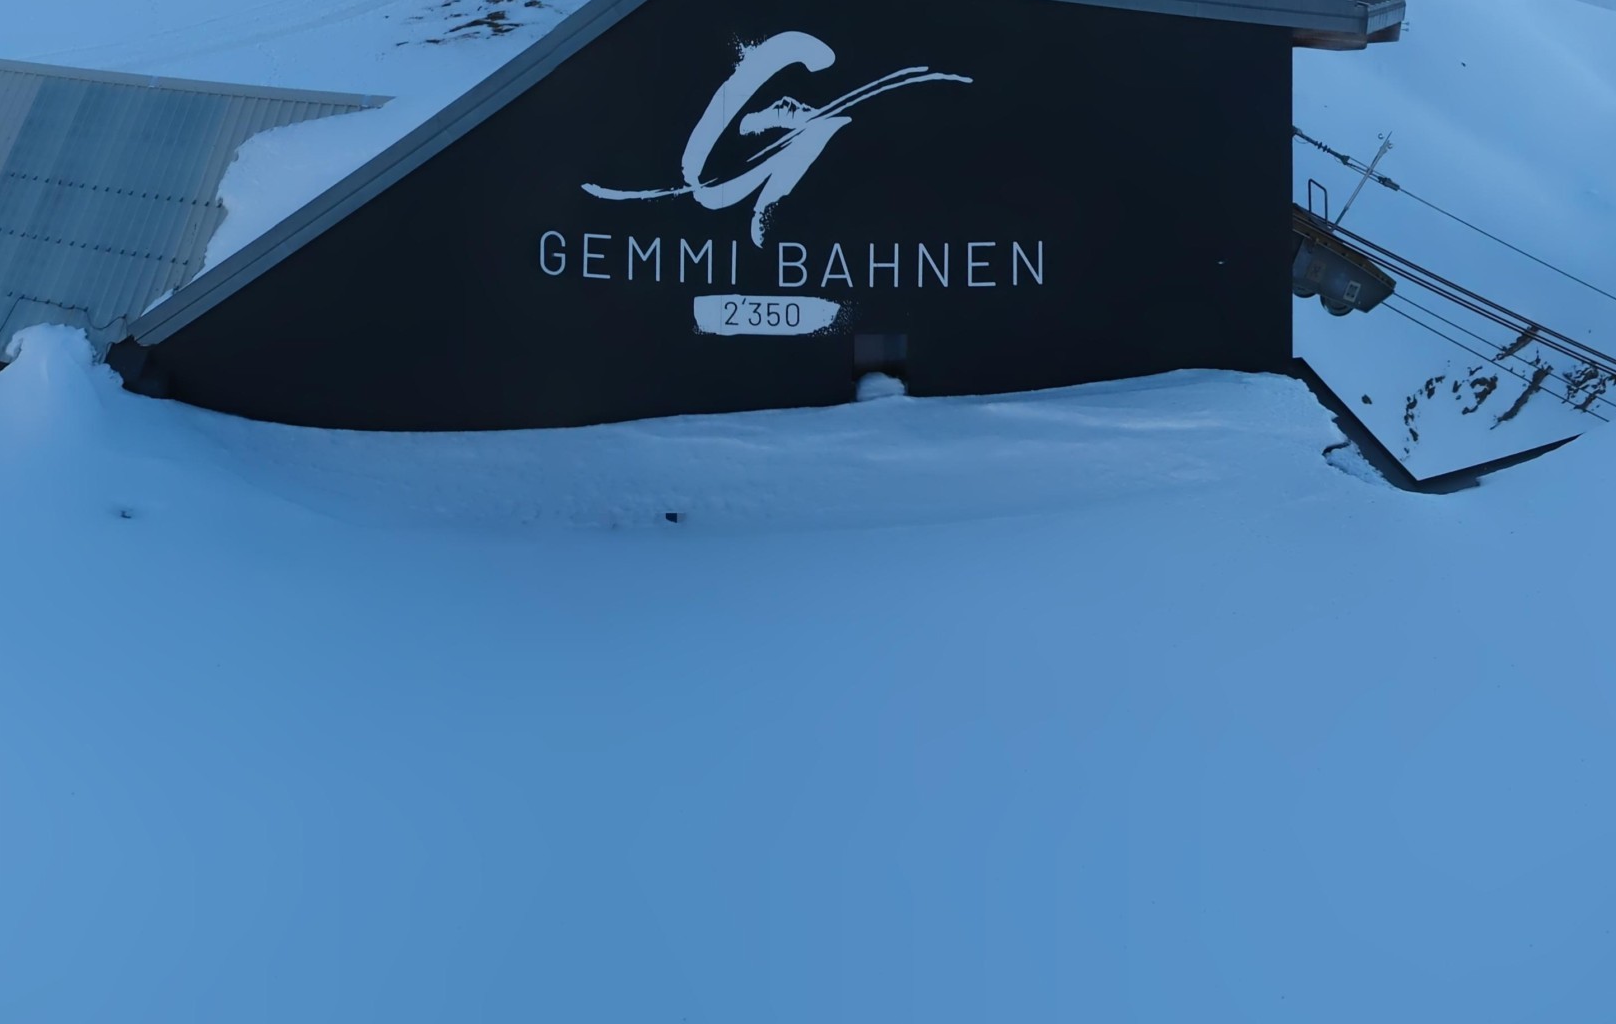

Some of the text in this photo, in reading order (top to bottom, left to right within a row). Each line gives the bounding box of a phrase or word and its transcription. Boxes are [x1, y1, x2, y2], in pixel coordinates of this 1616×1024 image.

[539, 230, 1043, 288] GEMMI BAHNEN
[723, 298, 801, 328] 2'350
